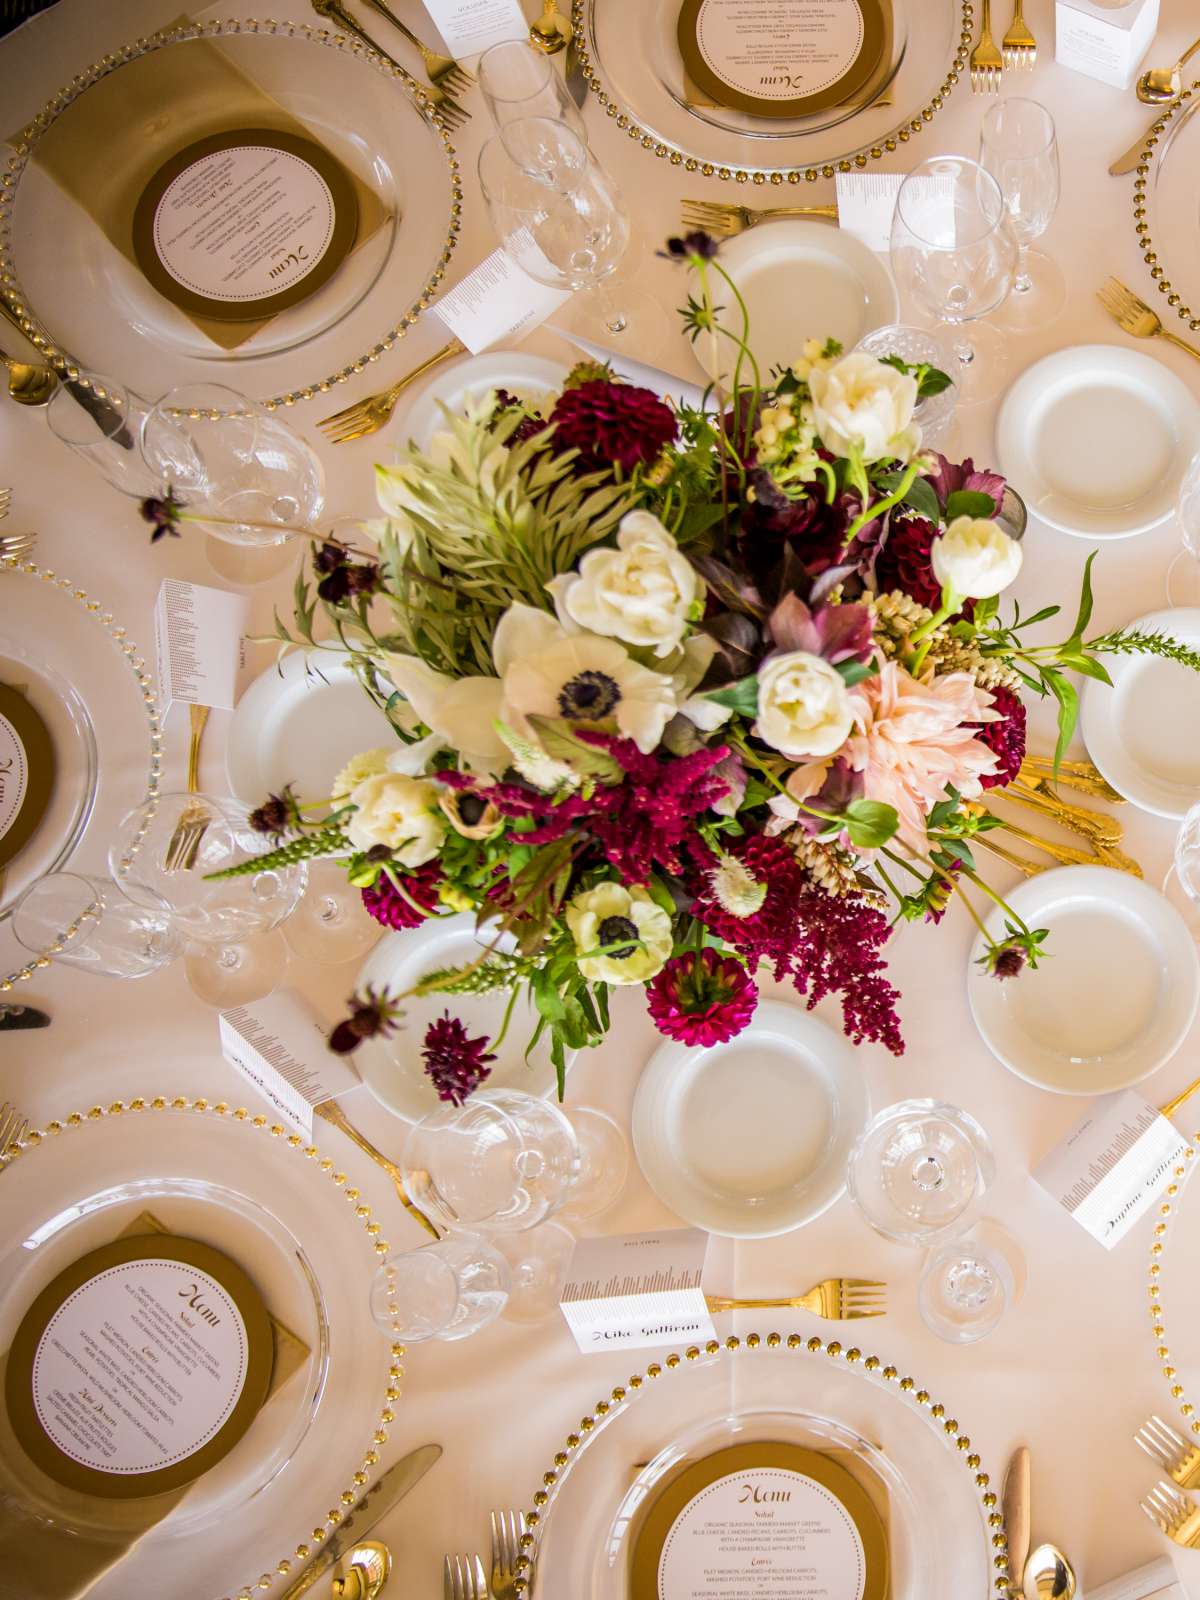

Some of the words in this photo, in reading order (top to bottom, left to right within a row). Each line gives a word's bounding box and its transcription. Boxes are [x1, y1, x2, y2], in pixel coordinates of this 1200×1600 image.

[760, 75, 804, 89] Menu
[269, 245, 309, 279] Menu
[178, 1283, 221, 1328] Menu
[641, 1323, 699, 1337] Sullivan
[737, 1483, 790, 1503] Menu
